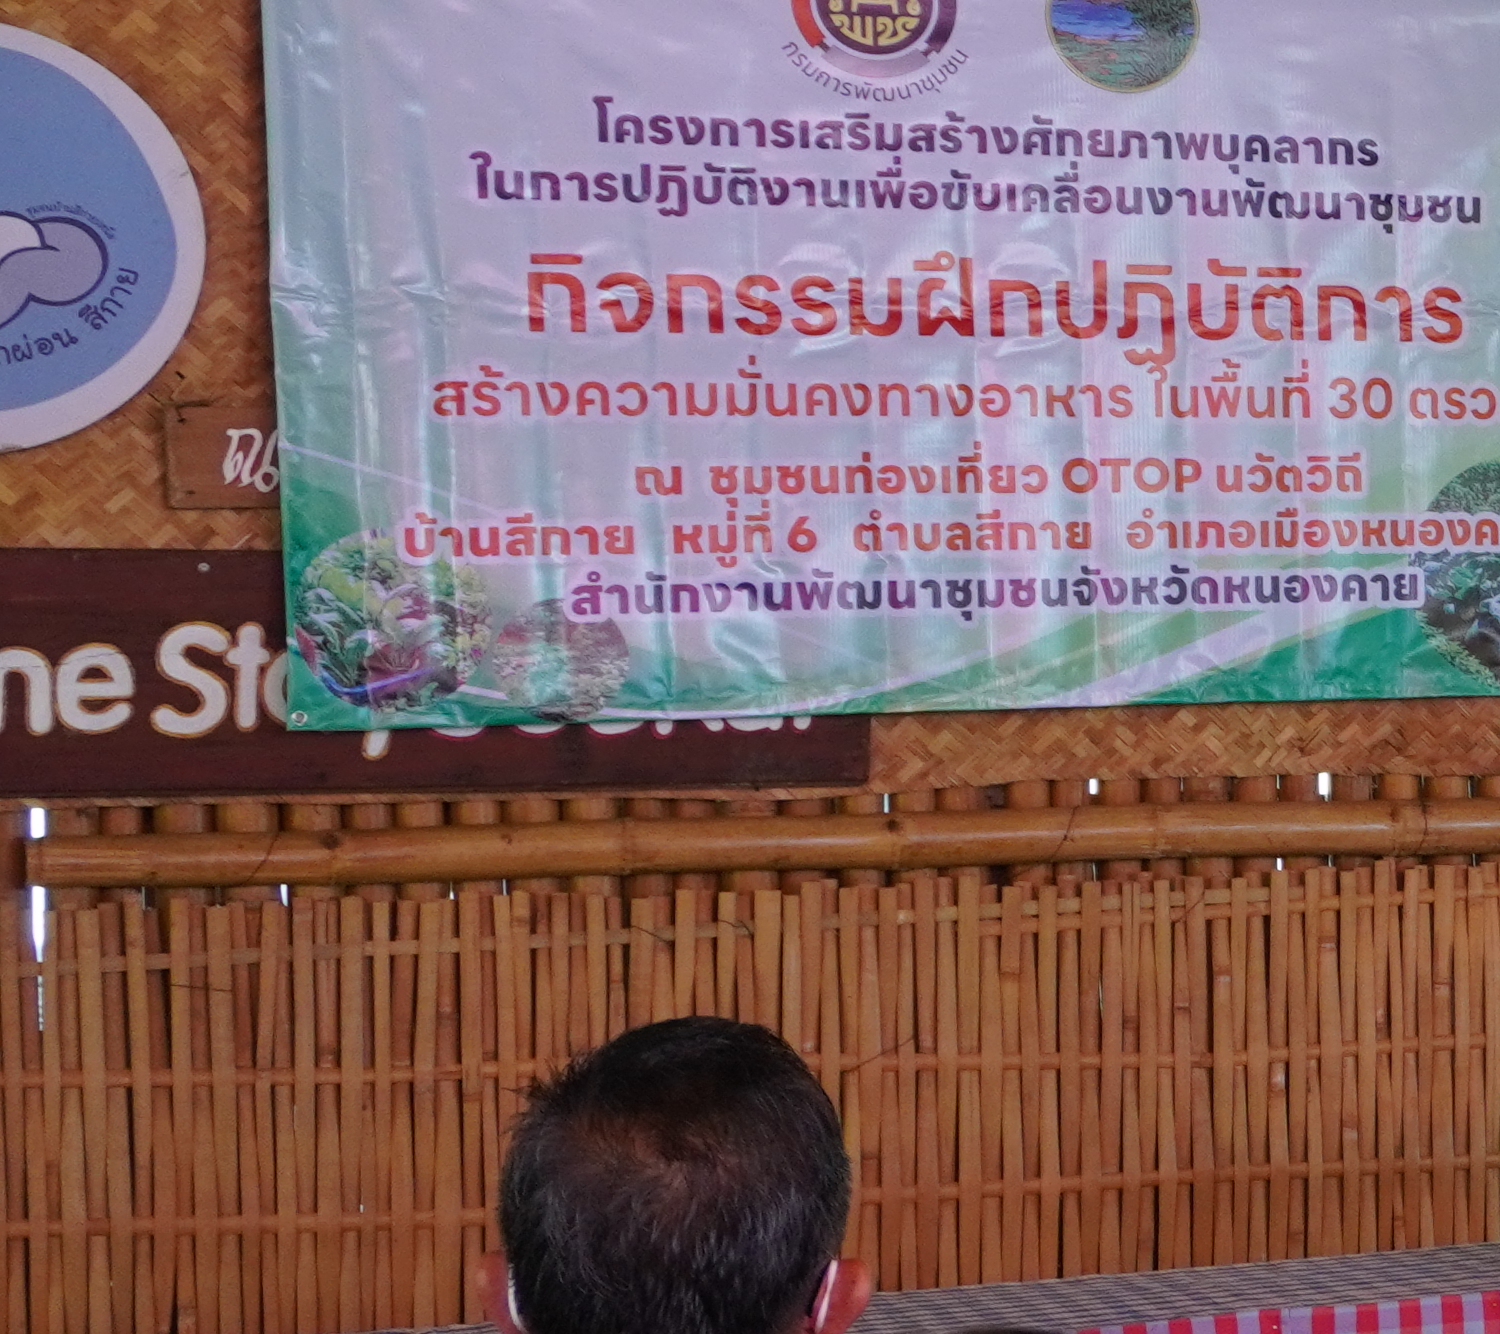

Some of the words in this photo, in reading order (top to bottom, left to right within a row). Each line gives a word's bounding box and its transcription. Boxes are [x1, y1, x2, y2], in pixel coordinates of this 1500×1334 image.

[781, 39, 970, 103] กรมการพัฒนาชุมชน
[591, 95, 1380, 178] โครงการเสริมสร้างศักยภาพบุคลากร
[470, 150, 1482, 233] ในการปฏิบัติงานเพื่อขับเคลื่อนงานพัฒนาชุมชน
[526, 250, 1465, 366] กิจกรรมฝึกปฏิบัติการ
[432, 354, 1134, 419] สร้างความมั่นคงทางอาหาร
[1145, 358, 1311, 420] ในพื้นที่
[1328, 377, 1393, 420] 30
[635, 464, 683, 496] ณ
[709, 440, 1049, 506] ชุมชนท่องเที่ยว
[1061, 457, 1203, 494] OTOP
[1215, 452, 1363, 494] นวัตวิถี
[403, 512, 634, 558] บ้านสีกาย
[672, 498, 774, 568] หมู่ที่
[787, 516, 817, 553] 6
[852, 503, 1092, 552] ตำบลสีกาย
[569, 564, 1419, 621] สำนักงานพัฒนาชุมชนจังหวัดหนองคาย
